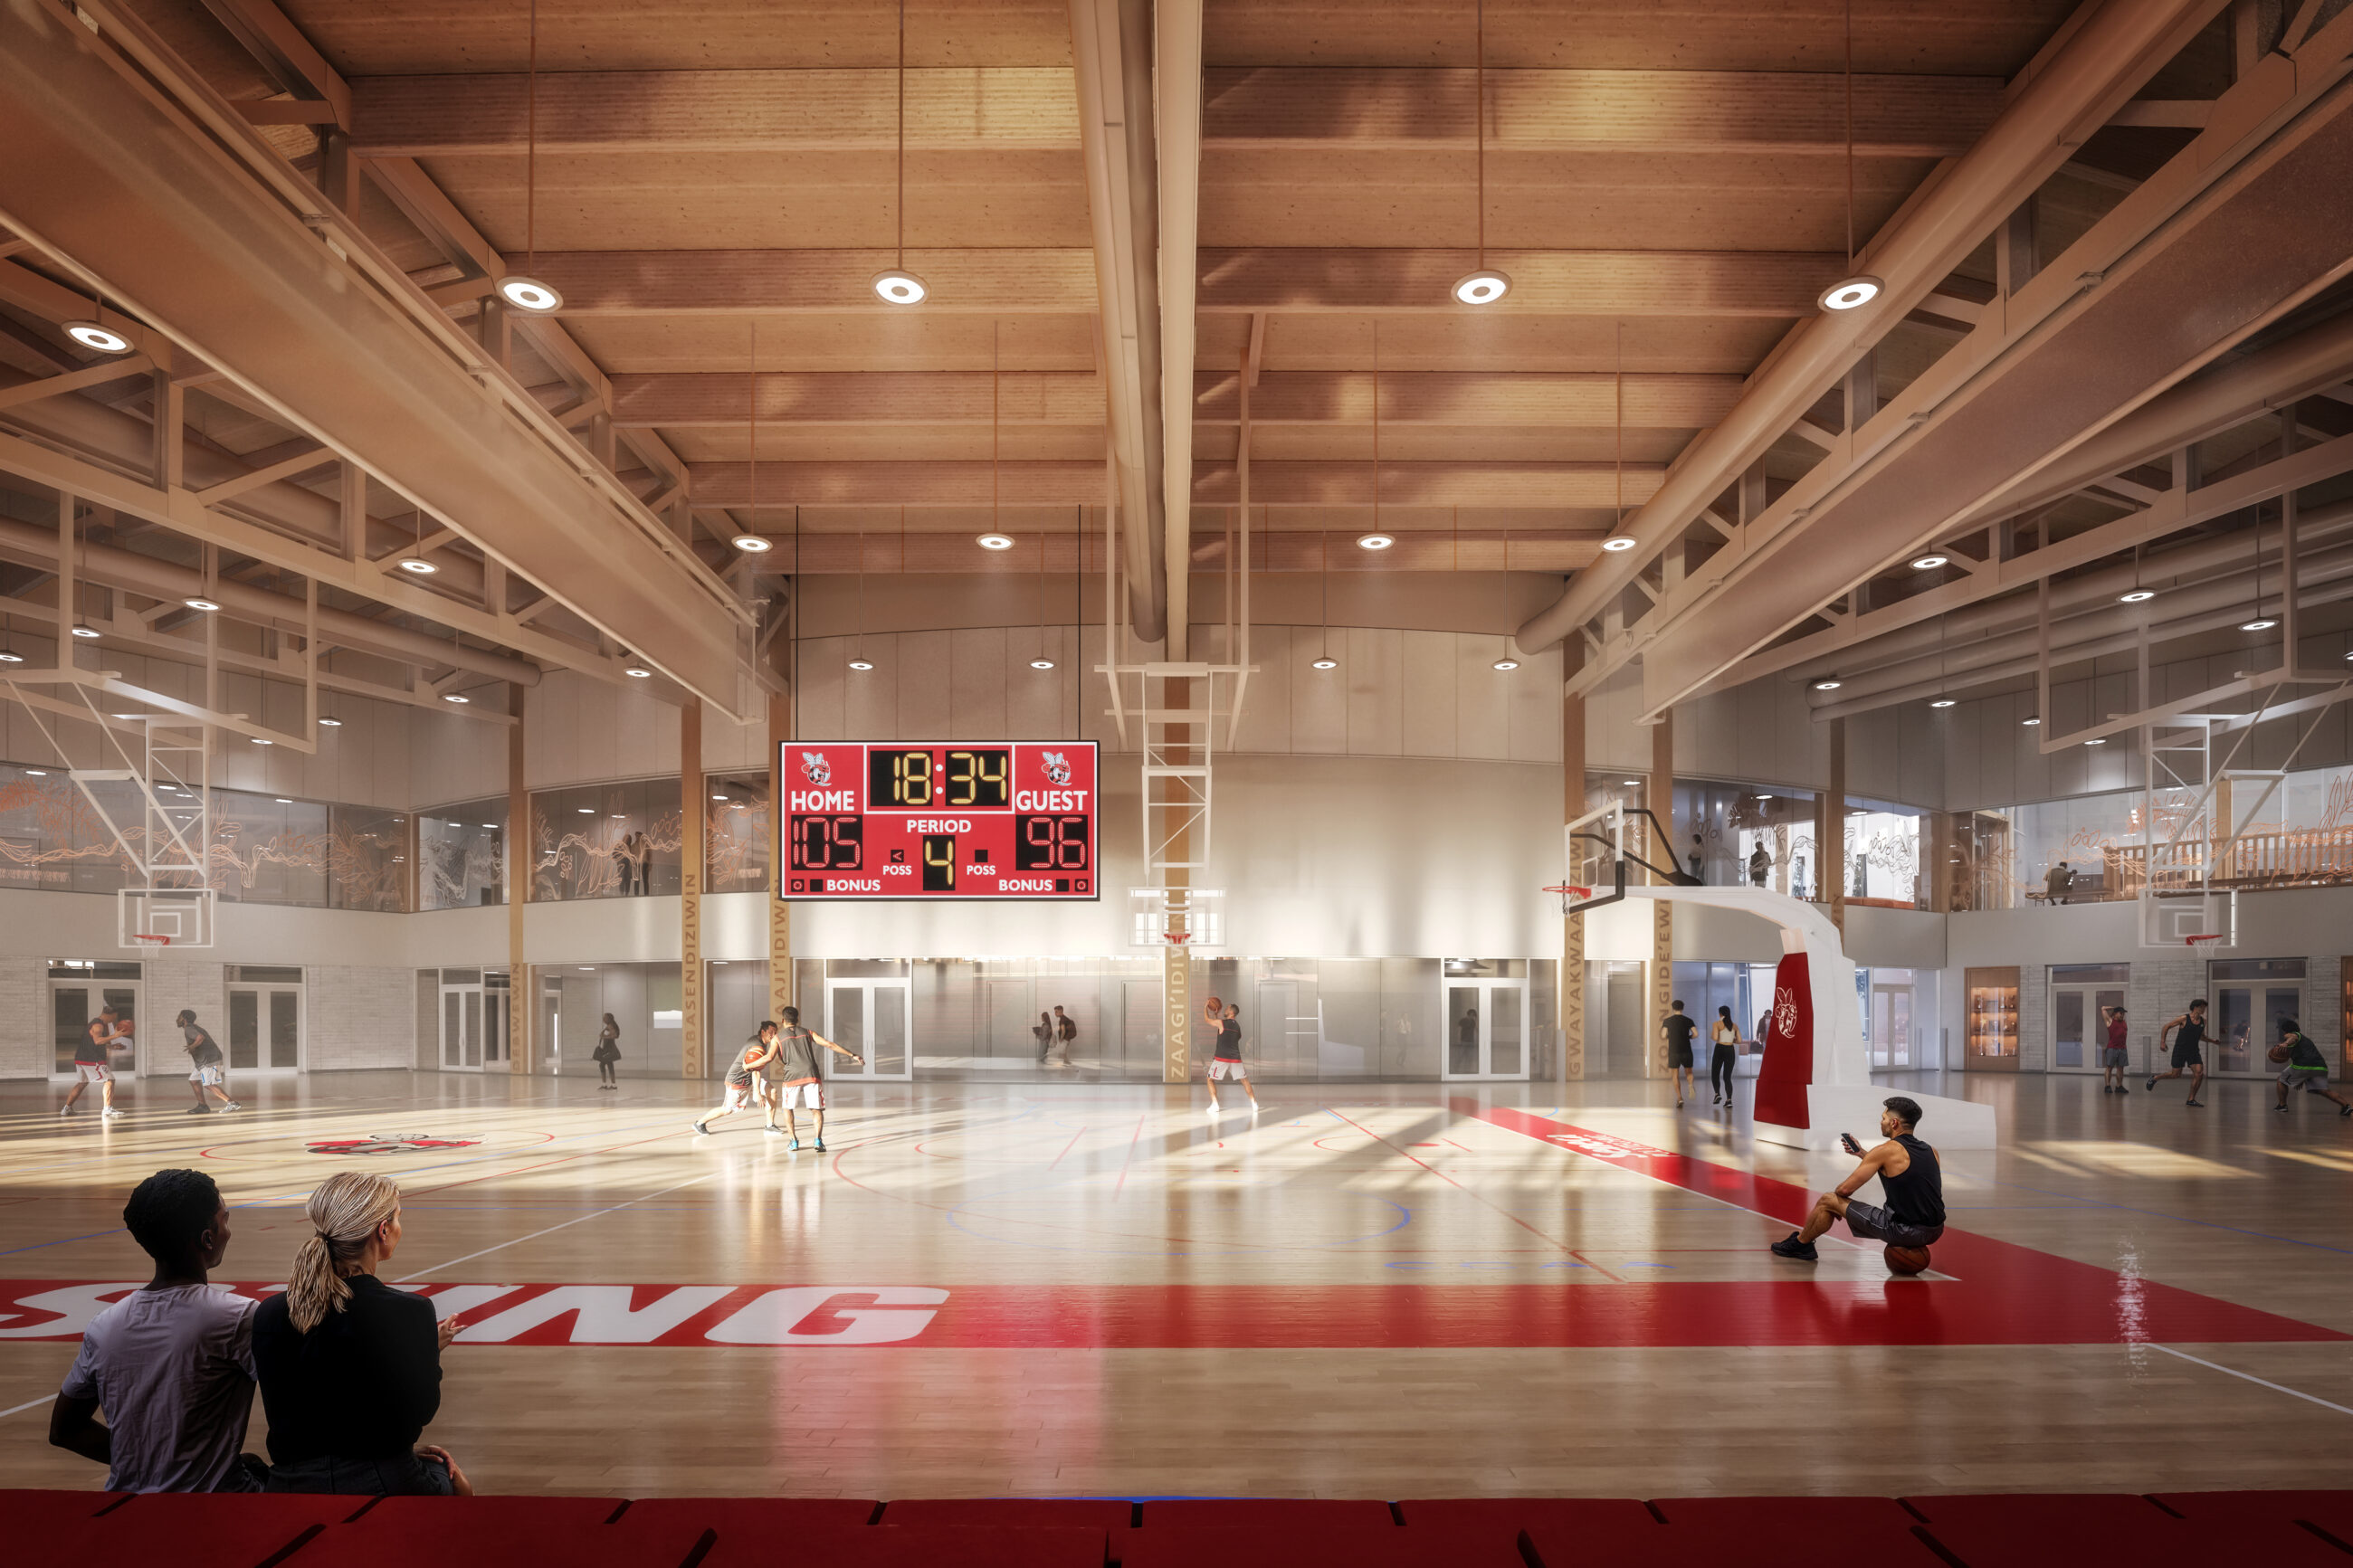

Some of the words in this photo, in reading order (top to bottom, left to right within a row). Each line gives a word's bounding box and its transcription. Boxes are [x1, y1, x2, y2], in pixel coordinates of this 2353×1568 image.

[894, 753, 1006, 804] 18:34
[791, 791, 854, 812] HOME
[1015, 790, 1088, 812] GUEST
[907, 820, 972, 833] PERIOD
[794, 817, 861, 868] 105
[1027, 817, 1085, 868] 96
[882, 865, 912, 876] POSS
[925, 841, 954, 886] 4
[966, 865, 996, 876] POSS
[826, 879, 881, 891] BONUS
[998, 879, 1053, 891] BONUS
[685, 874, 696, 1075] DABASENDIZIWIN
[0, 1282, 950, 1345] SING
